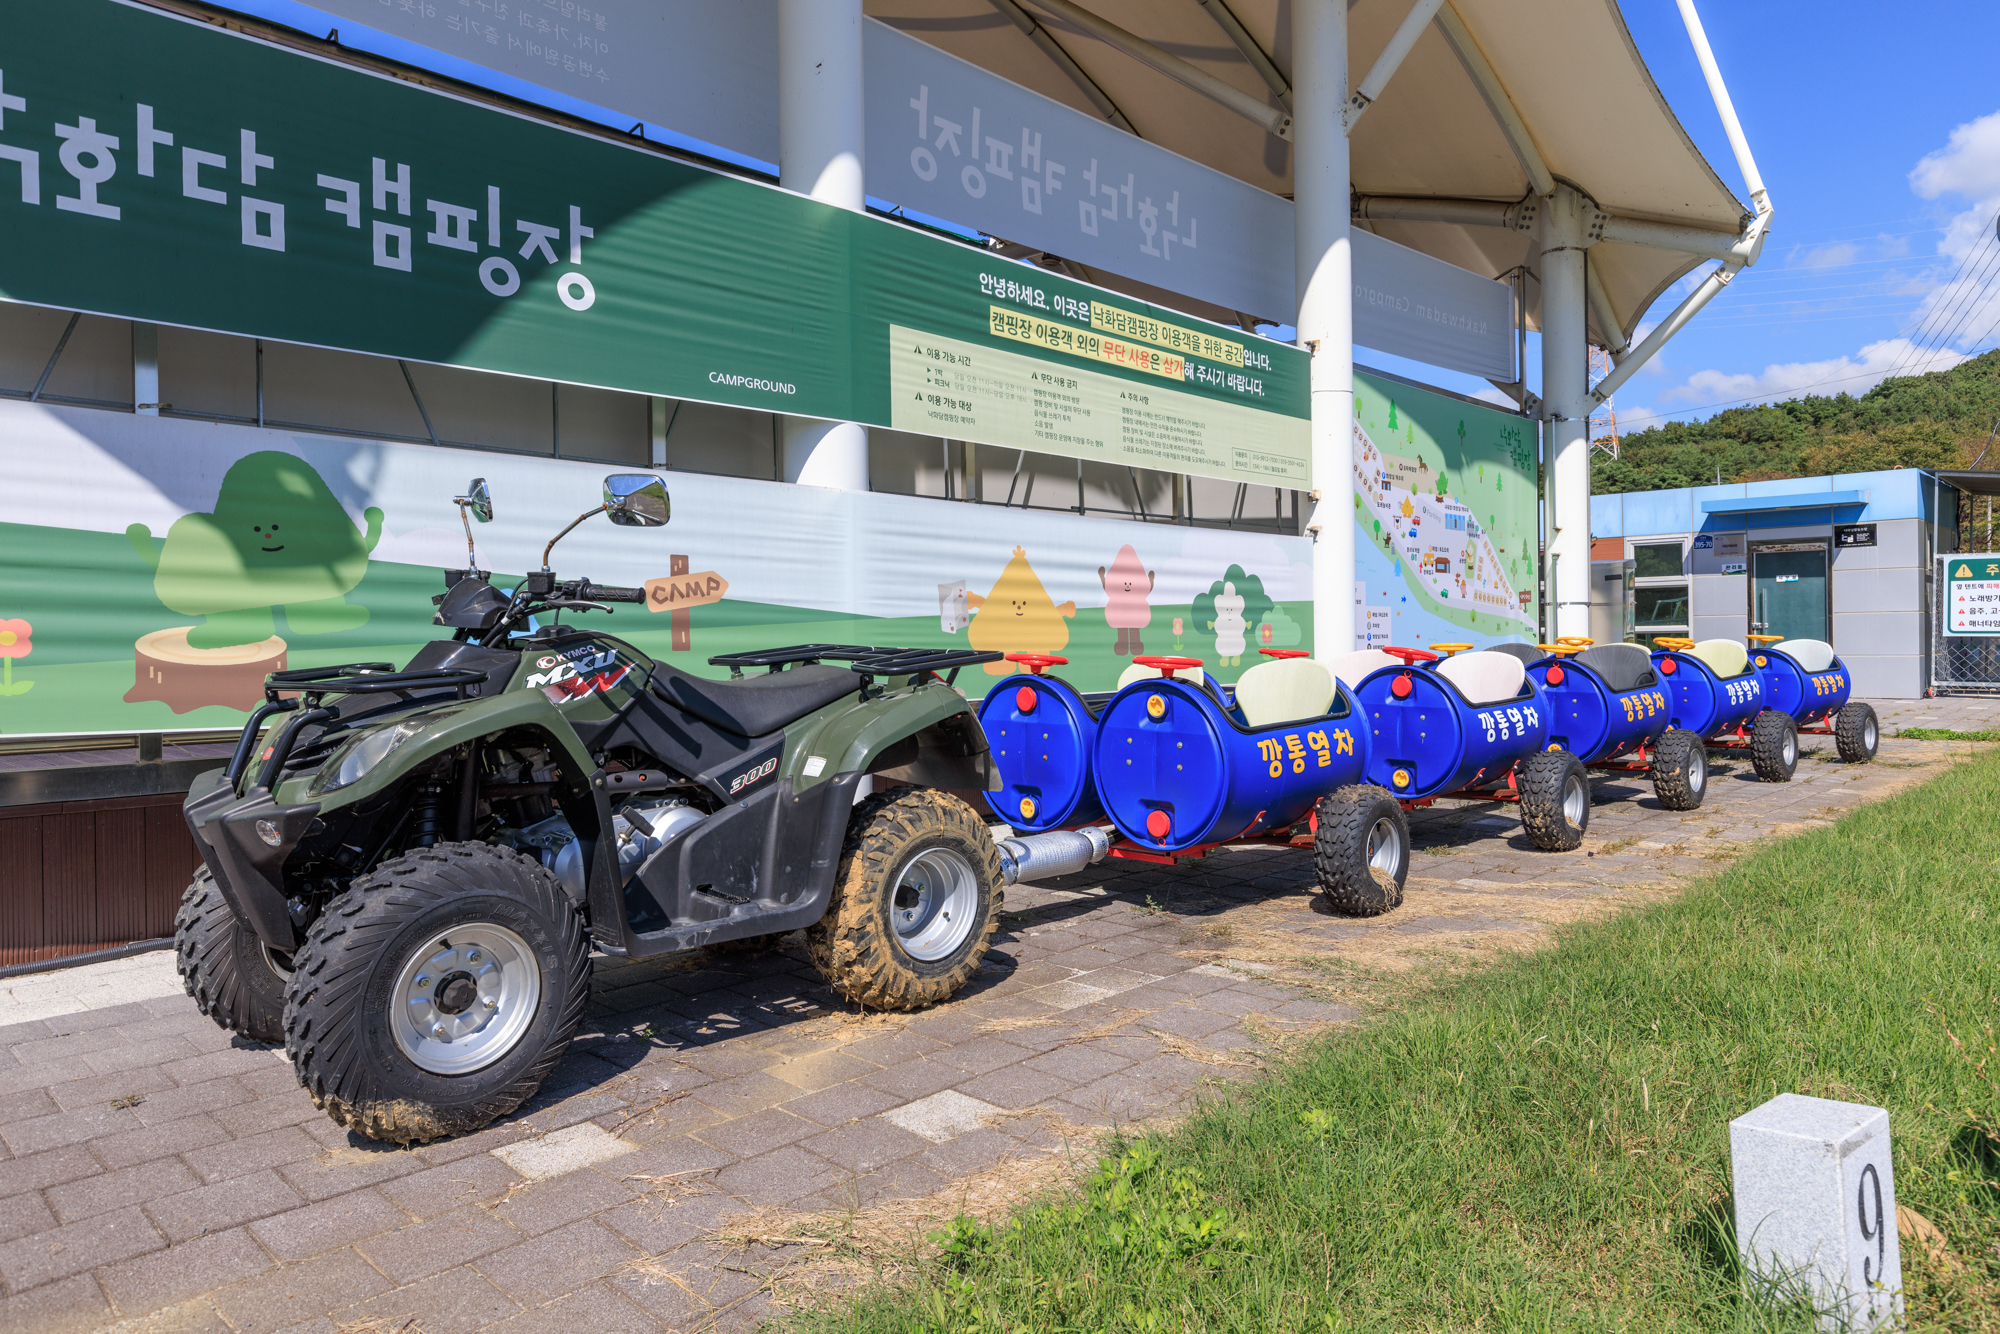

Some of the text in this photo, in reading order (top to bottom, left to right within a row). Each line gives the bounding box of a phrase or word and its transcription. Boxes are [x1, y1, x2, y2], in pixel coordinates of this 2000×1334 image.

[317, 157, 596, 311] 캠핑장
[979, 273, 1272, 371] 안녕하세요. 이곳은 낙화담캠핑장 이용객을 위한 공간입니다.
[927, 348, 971, 367] 이용 가능 시간
[991, 310, 1265, 397] 캠핑장 이용객 외의 무단 사용은 삼가해 주시기 바랍니다.
[708, 371, 796, 394] CAMPGROUND
[935, 378, 950, 388] 피크닉
[1041, 374, 1078, 389] 무단 사용 금지
[928, 394, 972, 412] 이용 가능 대상
[1128, 393, 1149, 405] 주의 사항
[1426, 506, 1441, 523] Parking
[1986, 564, 2000, 576] 주
[651, 576, 721, 605] CAMP
[556, 645, 597, 662] KYMCO
[526, 648, 619, 689] MXU
[1726, 679, 1760, 706] 깡통열차
[1811, 674, 1845, 696] 깡통열차
[1620, 692, 1665, 722] 깡통열차
[1477, 706, 1539, 743] 깡통열차
[1257, 728, 1355, 778] 깡통열차
[730, 757, 778, 794] 300
[1857, 1163, 1884, 1288] 9
